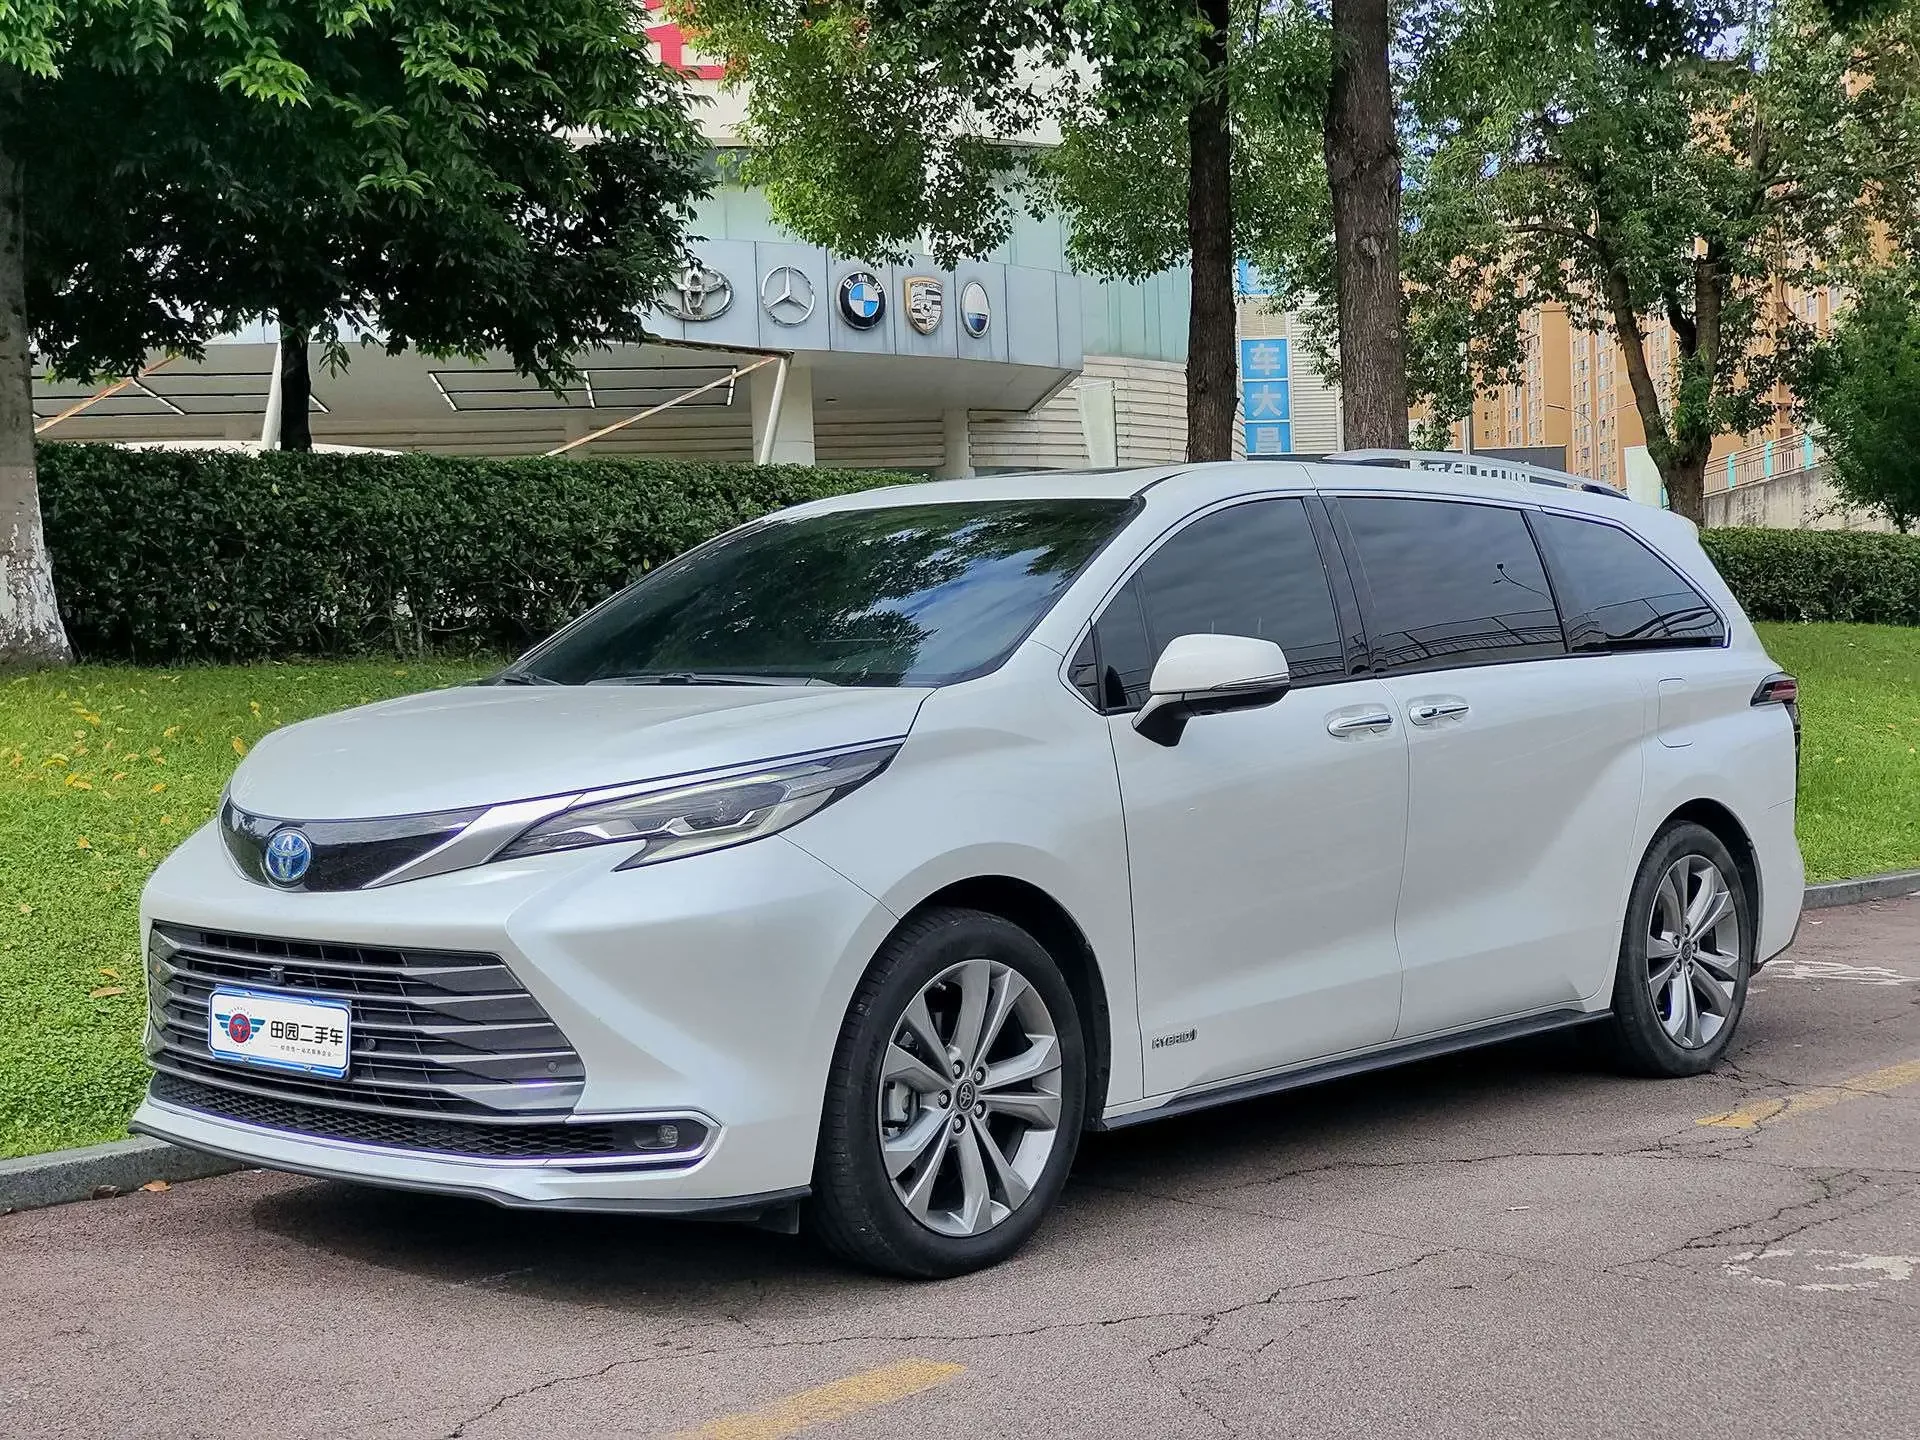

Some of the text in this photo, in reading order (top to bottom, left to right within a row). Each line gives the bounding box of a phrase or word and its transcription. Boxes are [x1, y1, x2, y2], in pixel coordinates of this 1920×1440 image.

[843, 274, 883, 293] BMW
[271, 1020, 344, 1046] 田园二手车
[1151, 1028, 1196, 1049] HYBRID
